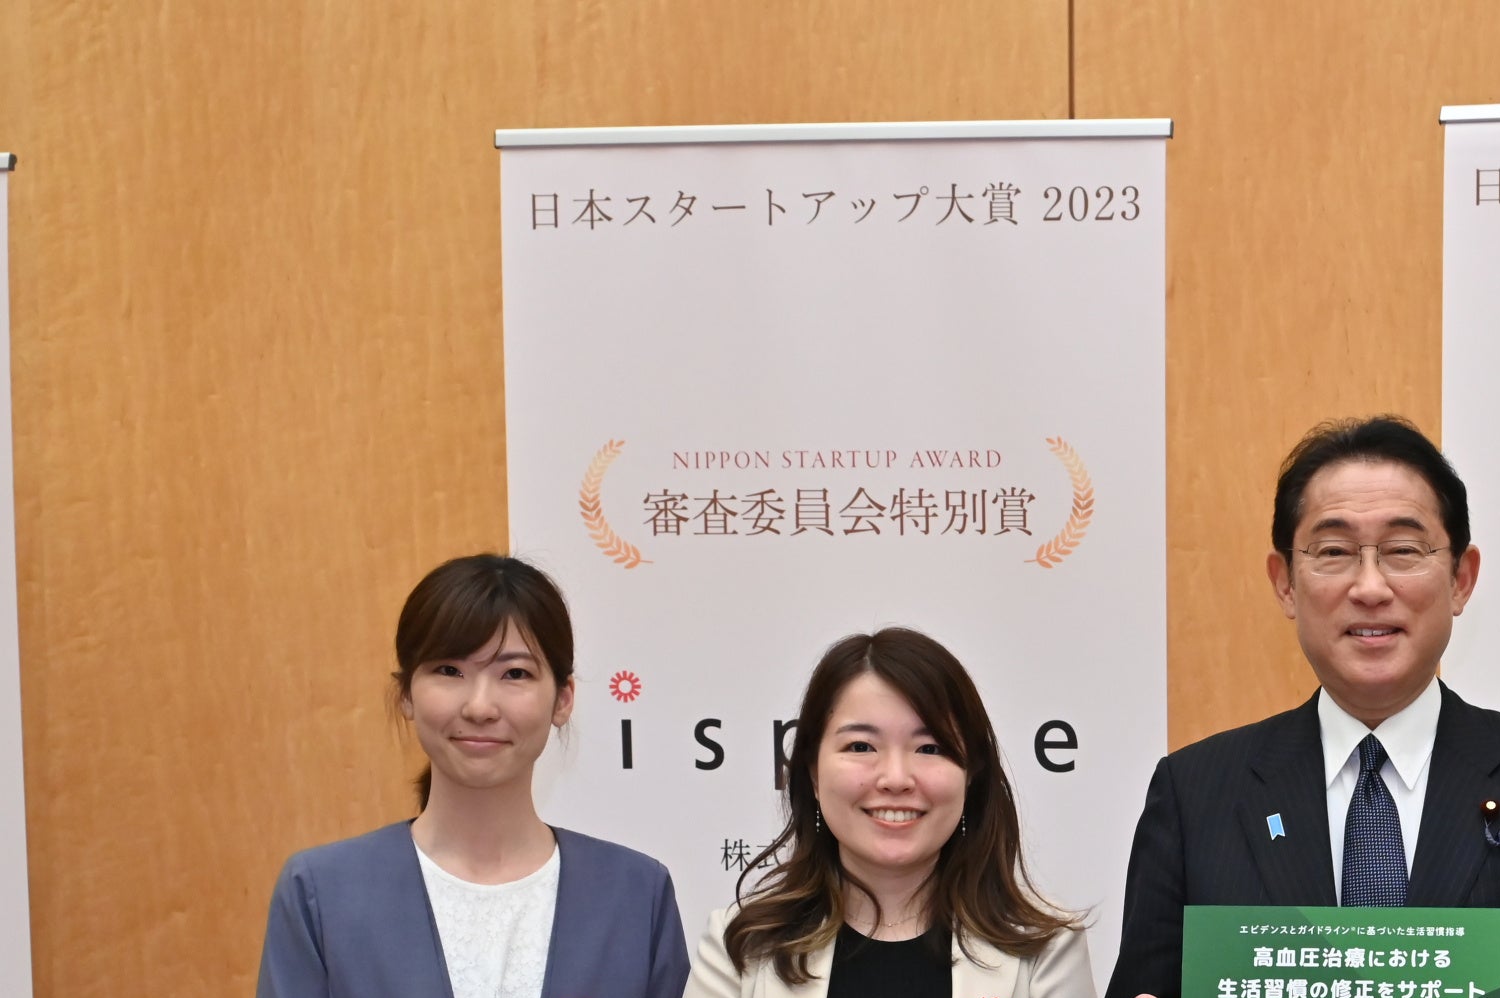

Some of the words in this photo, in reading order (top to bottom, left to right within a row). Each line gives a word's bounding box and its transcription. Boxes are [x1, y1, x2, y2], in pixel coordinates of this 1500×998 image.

[530, 182, 1022, 231] 日本スタートアップ大賞
[1042, 184, 1141, 223] 2023
[671, 450, 771, 471] NIPPON
[781, 449, 898, 471] STARTUP
[909, 449, 1002, 470] AWARD
[642, 486, 1036, 537] 審査委員会特別賞
[1253, 946, 1452, 969] 高血圧治療における
